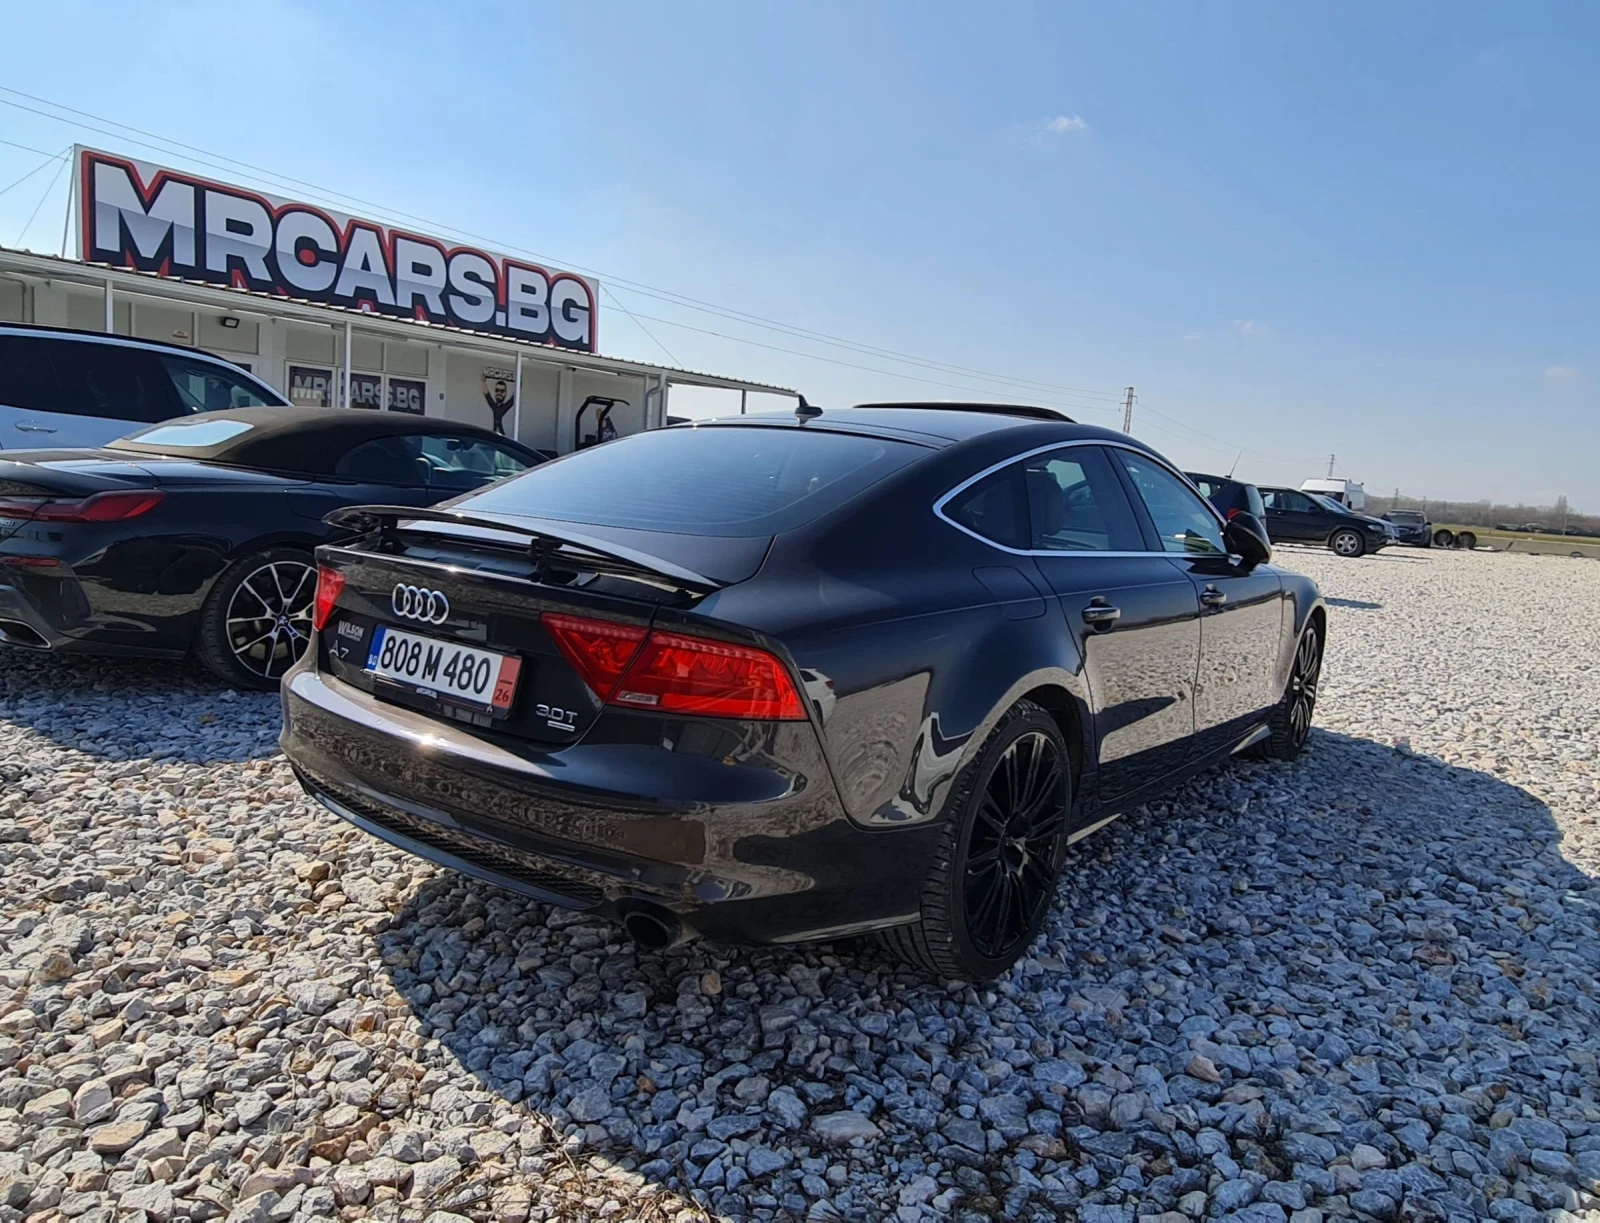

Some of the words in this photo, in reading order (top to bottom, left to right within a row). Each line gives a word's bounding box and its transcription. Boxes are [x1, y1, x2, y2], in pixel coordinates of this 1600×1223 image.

[94, 161, 590, 345] MRCARS.BG
[338, 620, 365, 638] WILSON
[329, 640, 350, 659] A7
[368, 654, 378, 667] BG
[380, 635, 422, 677] 808
[421, 646, 445, 683] M
[442, 653, 492, 695] 480
[495, 688, 510, 703] 26
